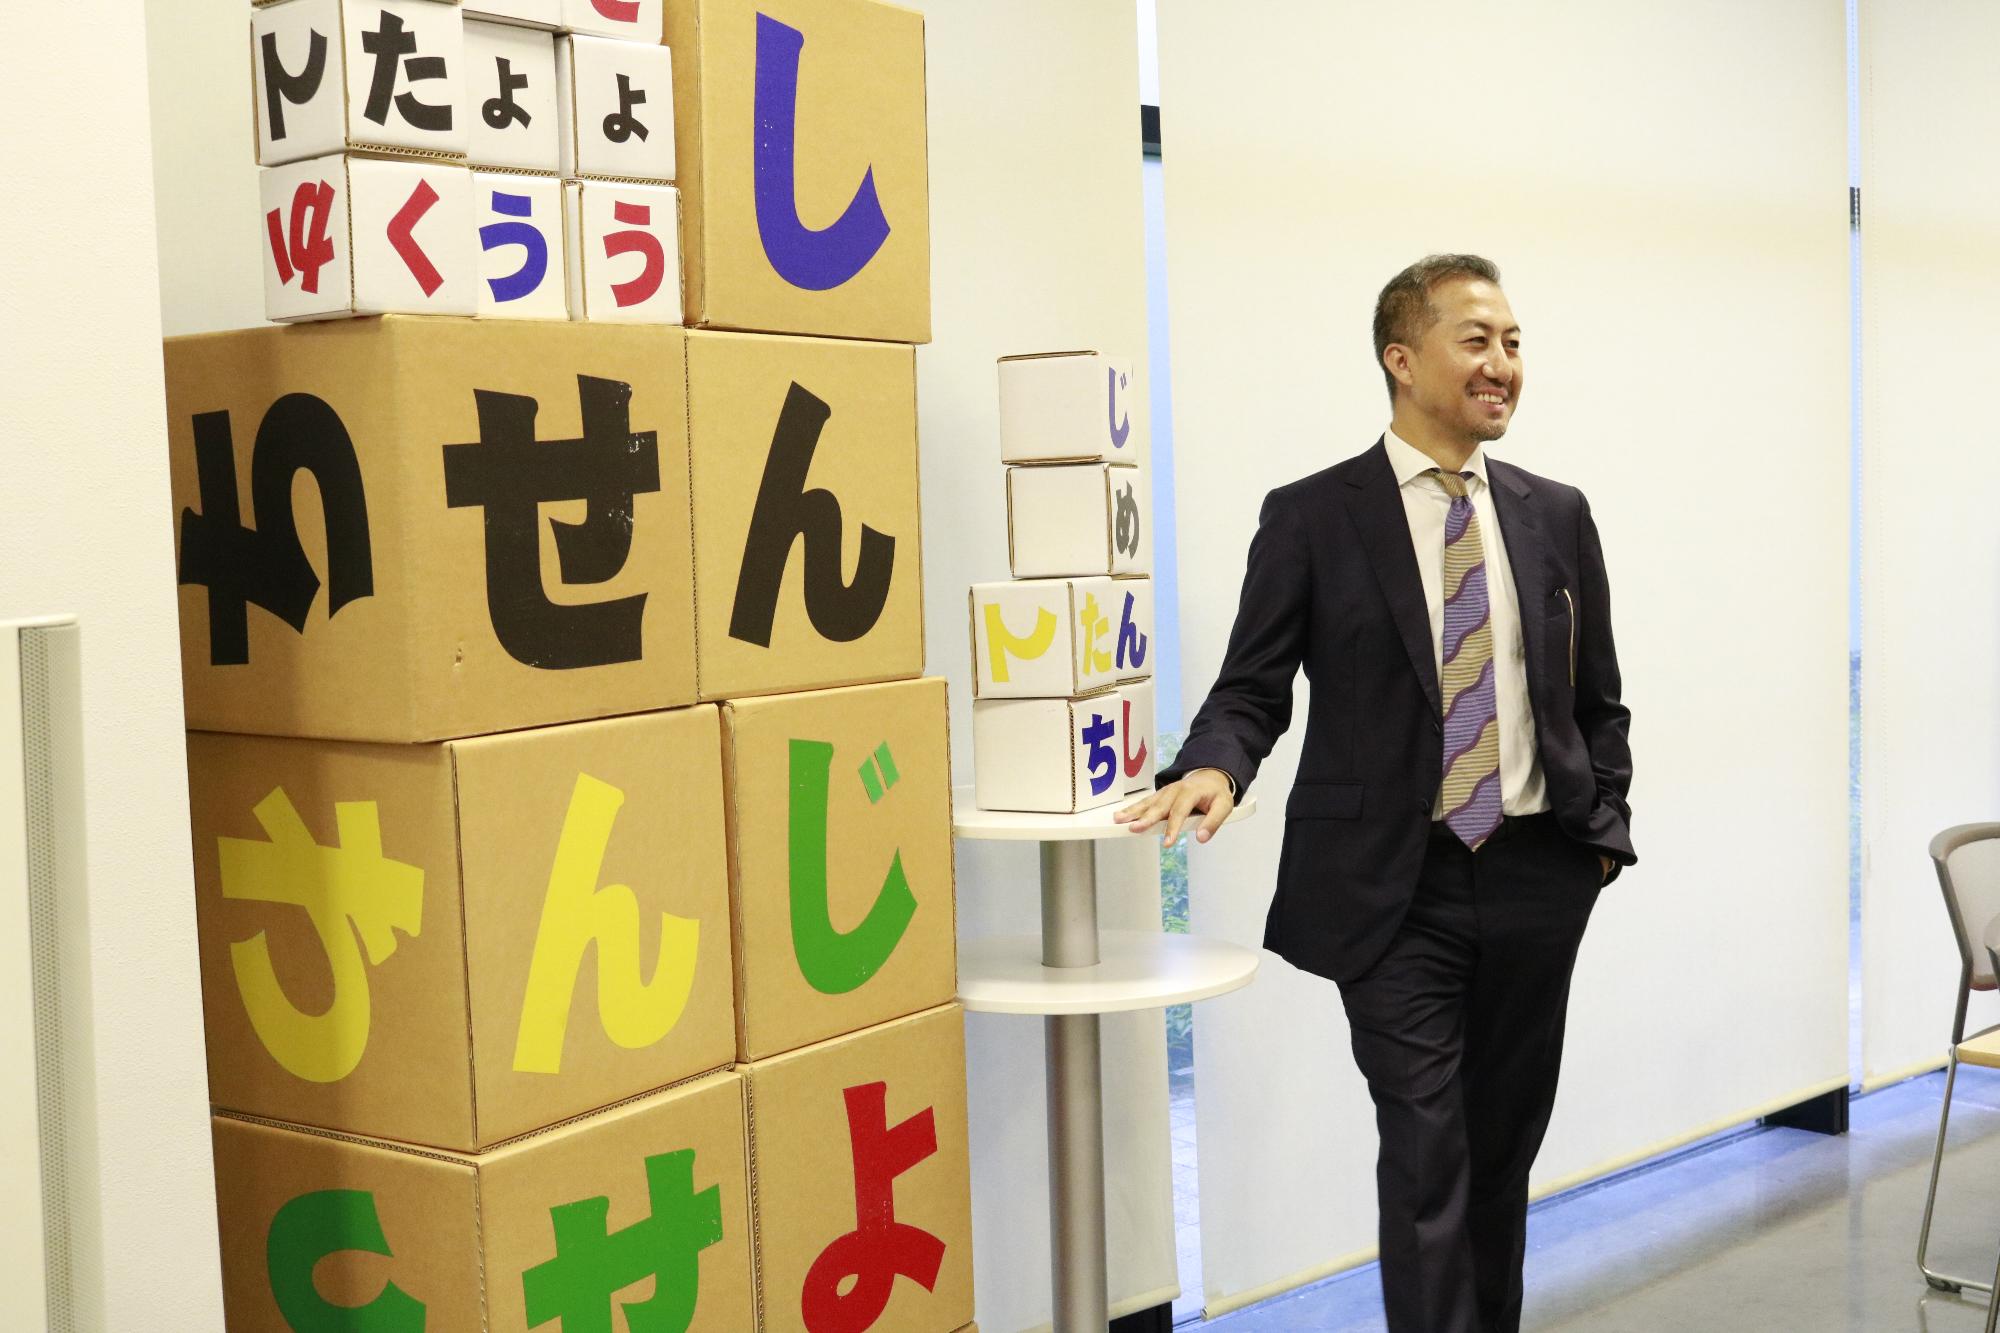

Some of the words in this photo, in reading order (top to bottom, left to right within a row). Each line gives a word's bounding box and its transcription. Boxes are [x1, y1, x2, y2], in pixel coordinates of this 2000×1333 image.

[361, 10, 453, 131] た
[755, 11, 891, 291] し
[387, 178, 444, 297] く
[479, 191, 548, 302] う
[603, 200, 665, 307] う
[1109, 366, 1129, 448] じ
[442, 374, 661, 670] せ
[728, 380, 896, 648] ん
[1116, 480, 1140, 559] め
[1080, 592, 1112, 676] た
[1115, 590, 1147, 669] ん
[1082, 713, 1117, 796] ち
[1122, 700, 1147, 778] し
[513, 771, 700, 1075] ん
[789, 739, 918, 995] じ
[801, 1080, 946, 1333] よ
